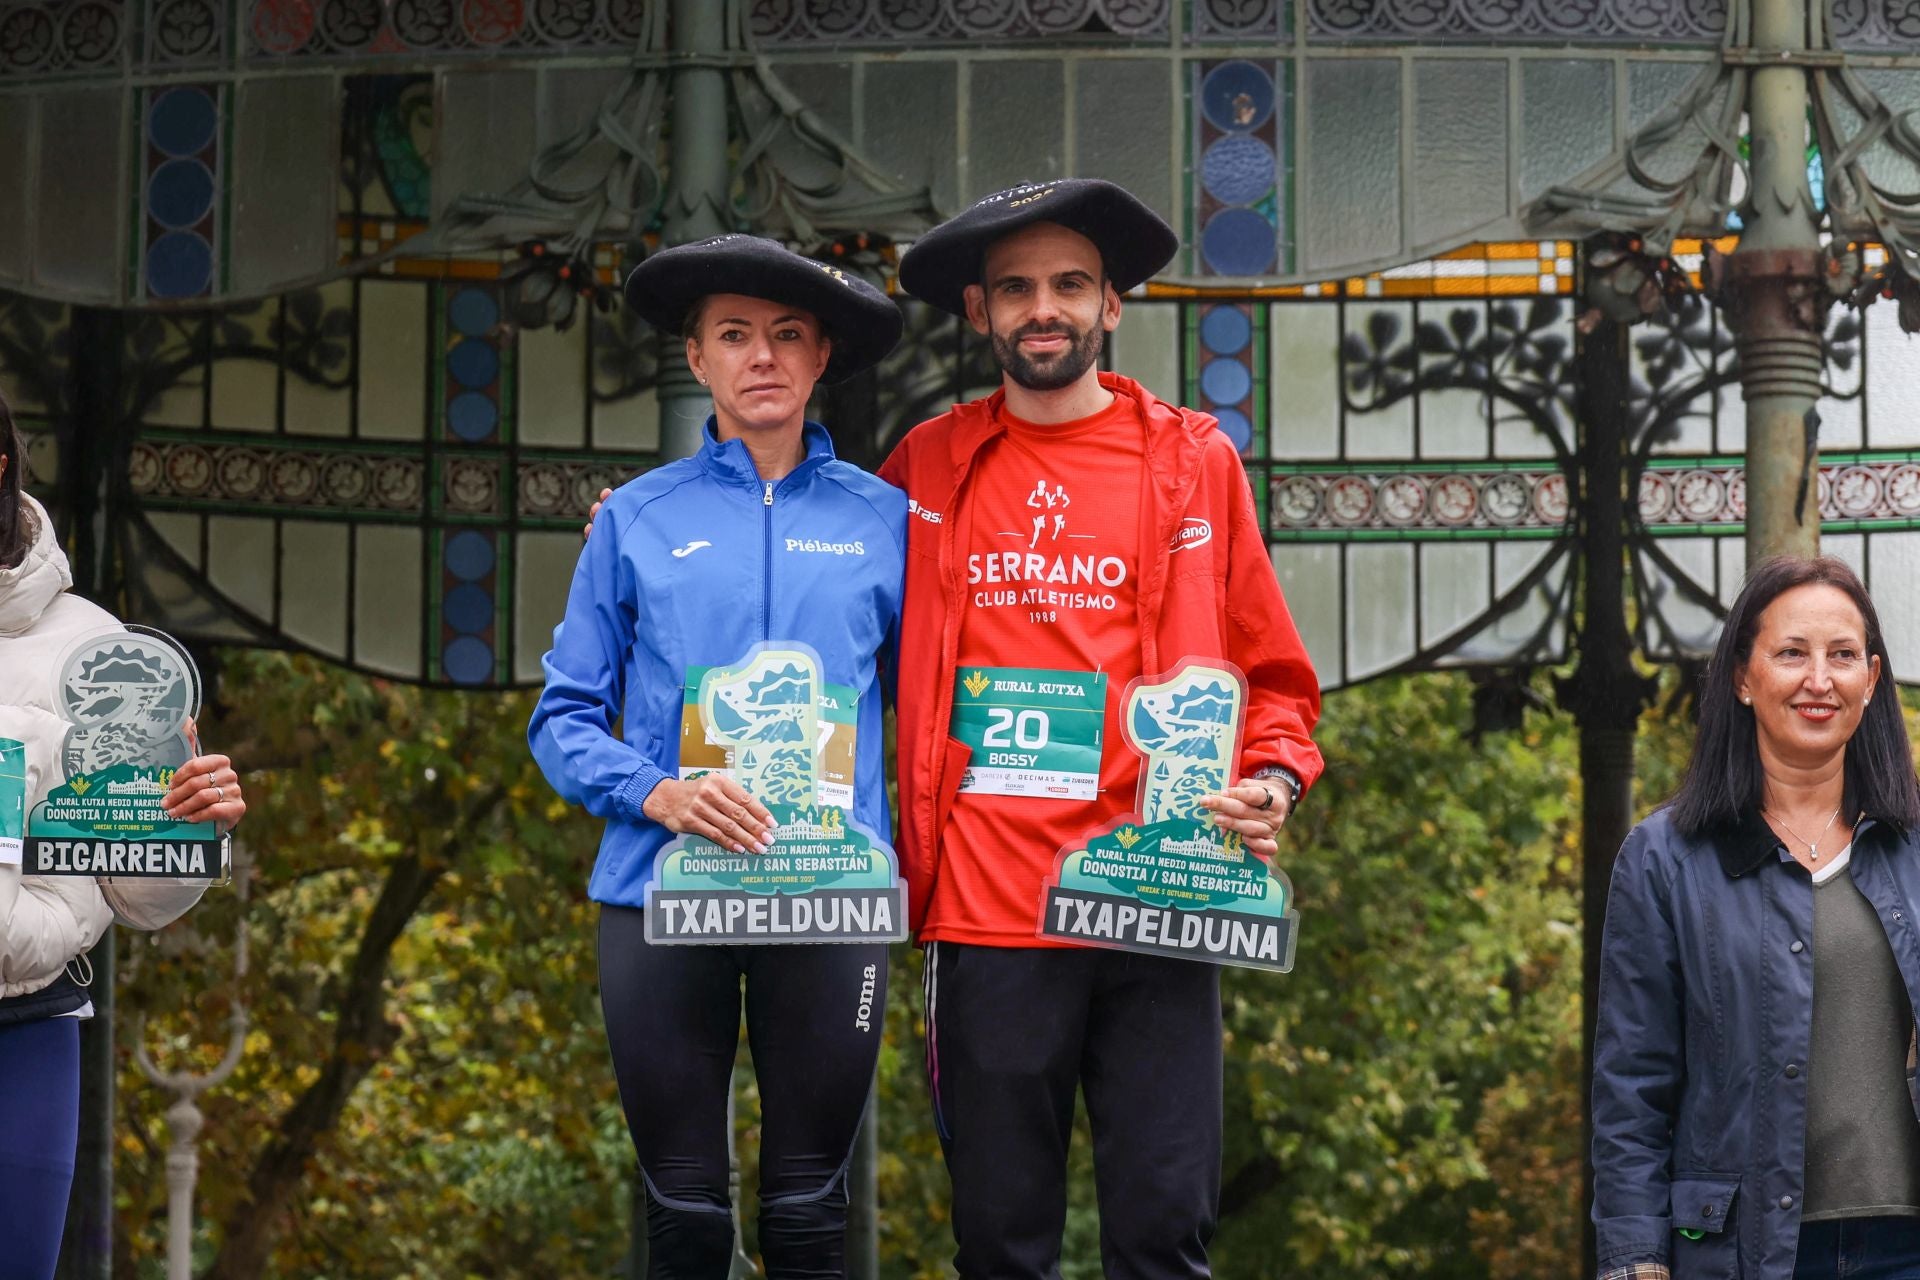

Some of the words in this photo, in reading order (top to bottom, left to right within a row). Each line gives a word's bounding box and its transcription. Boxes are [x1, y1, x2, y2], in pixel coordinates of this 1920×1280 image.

[968, 551, 1126, 587] SERRANO
[975, 590, 1017, 607] CLUB
[1021, 588, 1116, 610] ATLETISMO
[1029, 611, 1057, 623] 1988
[994, 680, 1035, 693] RURAL
[1038, 682, 1086, 697] KUTXA
[982, 707, 1050, 750] 20
[989, 752, 1039, 767] BOSSY
[1018, 774, 1055, 782] DECIMAS
[56, 798, 80, 806] RURAL
[82, 798, 105, 806] KUTXA
[107, 799, 131, 807] MEDIO
[133, 797, 161, 807] MARATÓ
[47, 808, 100, 820] DONOSTIA
[104, 810, 109, 820] /
[112, 810, 134, 820] SAN
[37, 841, 206, 874] BIGARRENA
[695, 846, 724, 856] RURAL
[789, 844, 830, 855] MARATÓN
[684, 858, 749, 873] DONOSTIA
[753, 859, 759, 872] /
[764, 859, 790, 872] SAN
[795, 855, 868, 872] SEBASTIÁN
[1096, 849, 1124, 861] RURAL
[1127, 852, 1155, 866] KUTXA
[1158, 857, 1185, 869] MEDIO
[1189, 862, 1228, 876] MARATÓN
[771, 875, 798, 883] OCTUBRE
[1083, 860, 1147, 881] DONOSTIA
[1151, 869, 1158, 882] /
[1161, 871, 1187, 887] SAN
[1192, 876, 1263, 897] SEBASTIÁN
[660, 897, 893, 934] TXAPELDUNA
[1054, 896, 1279, 961] TXAPELDUNA
